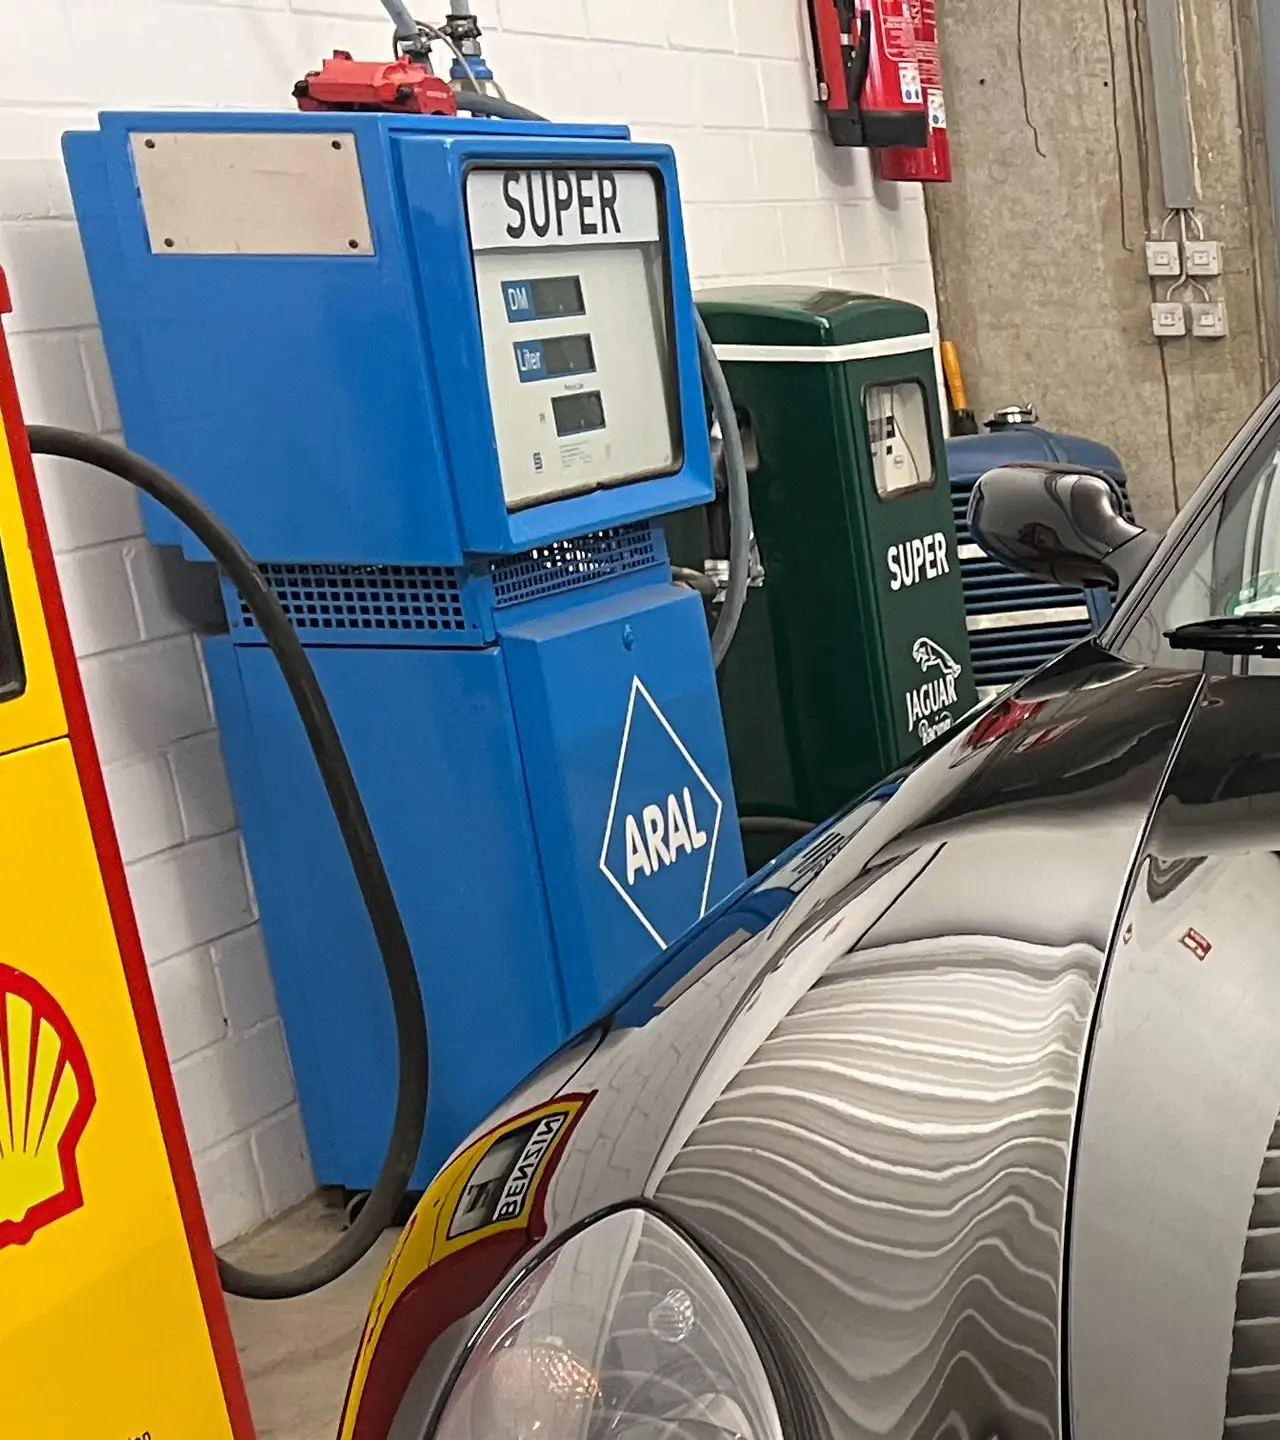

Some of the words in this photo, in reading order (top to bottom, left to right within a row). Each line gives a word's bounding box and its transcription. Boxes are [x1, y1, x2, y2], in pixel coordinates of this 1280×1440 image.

[502, 170, 622, 239] SUPER
[507, 287, 530, 312] DM
[517, 348, 541, 372] Liter
[888, 531, 950, 591] SUPER
[906, 674, 958, 733] JAGUAR
[625, 786, 708, 885] ARAL
